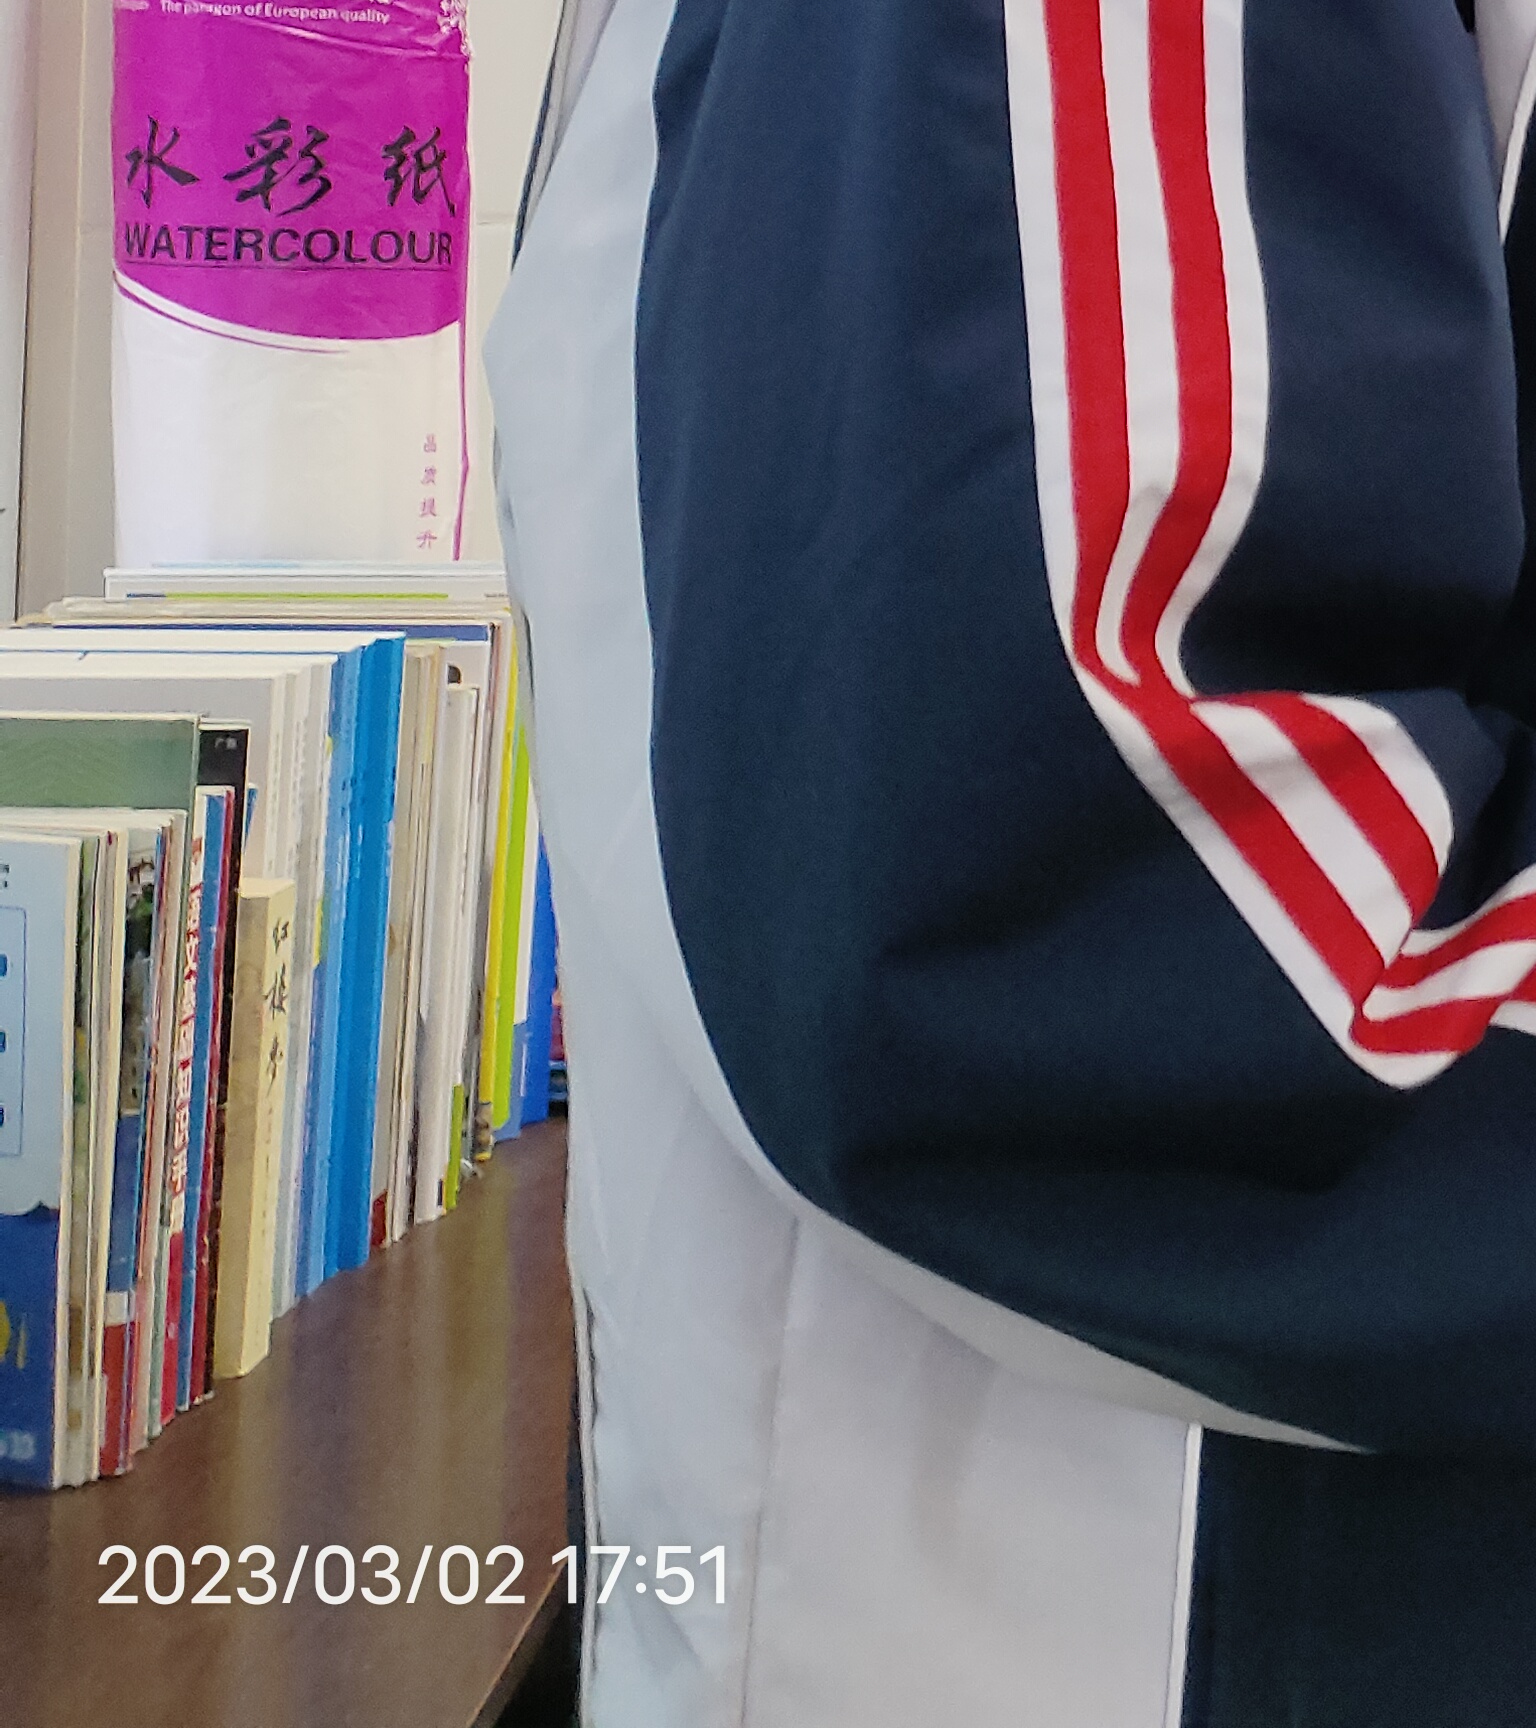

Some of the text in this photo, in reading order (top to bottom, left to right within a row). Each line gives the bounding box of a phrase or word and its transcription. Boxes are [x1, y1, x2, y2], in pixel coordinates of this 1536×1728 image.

[264, 2, 339, 22] European
[340, 8, 391, 25] quality
[125, 115, 456, 218] 水彩纸
[124, 224, 454, 266] WATERCOLOUR
